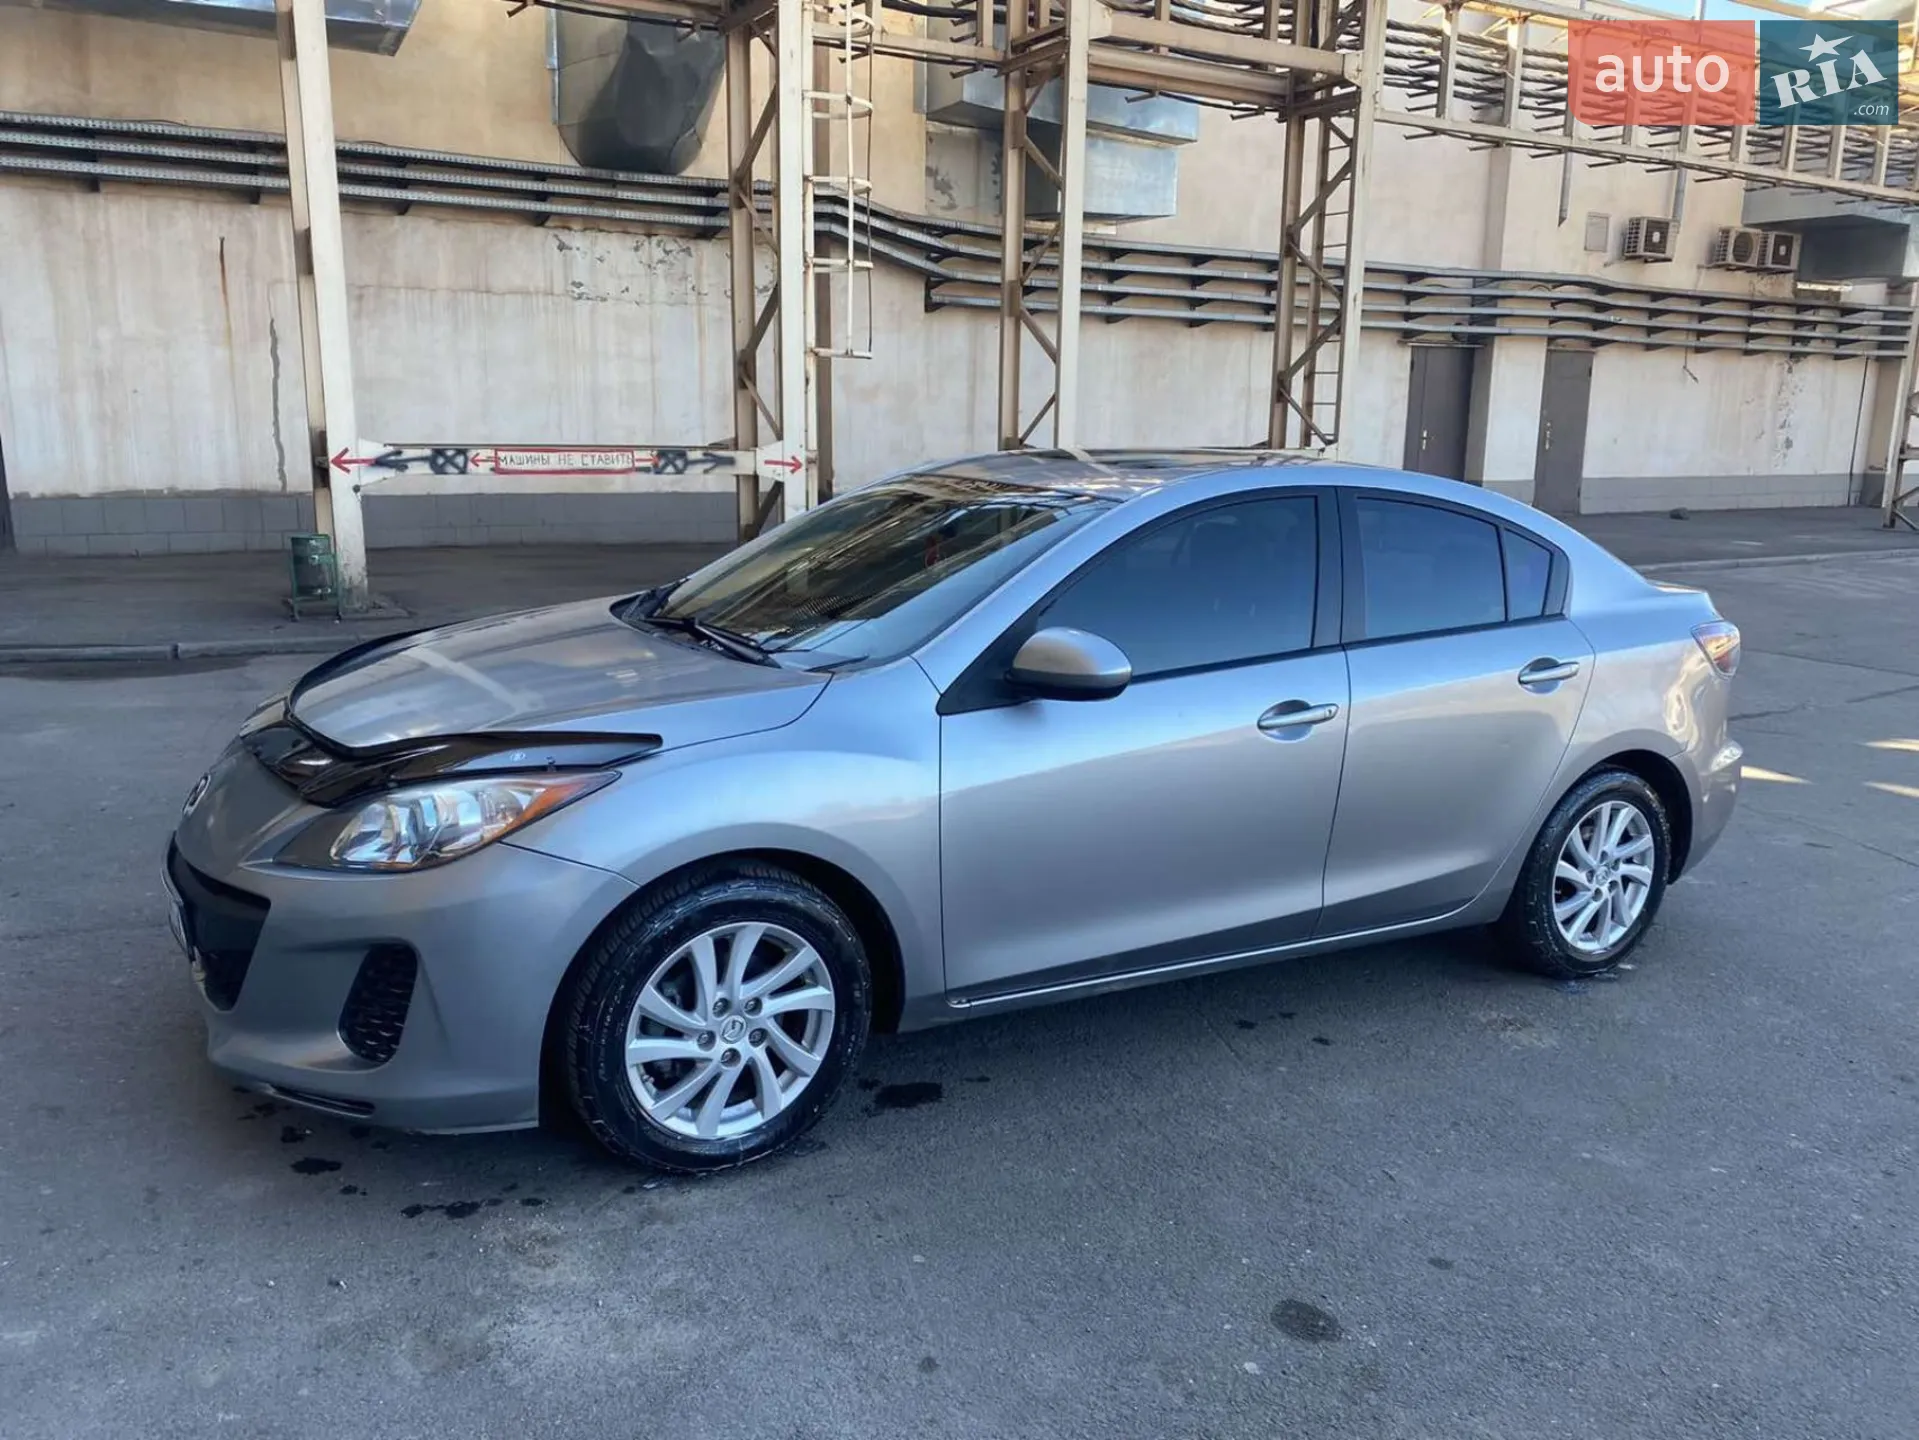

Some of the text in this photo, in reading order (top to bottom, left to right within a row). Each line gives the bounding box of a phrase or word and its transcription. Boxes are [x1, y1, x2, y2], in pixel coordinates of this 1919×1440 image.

[498, 453, 634, 467] МАШИНЫ НЕ СТАВИТЬ
